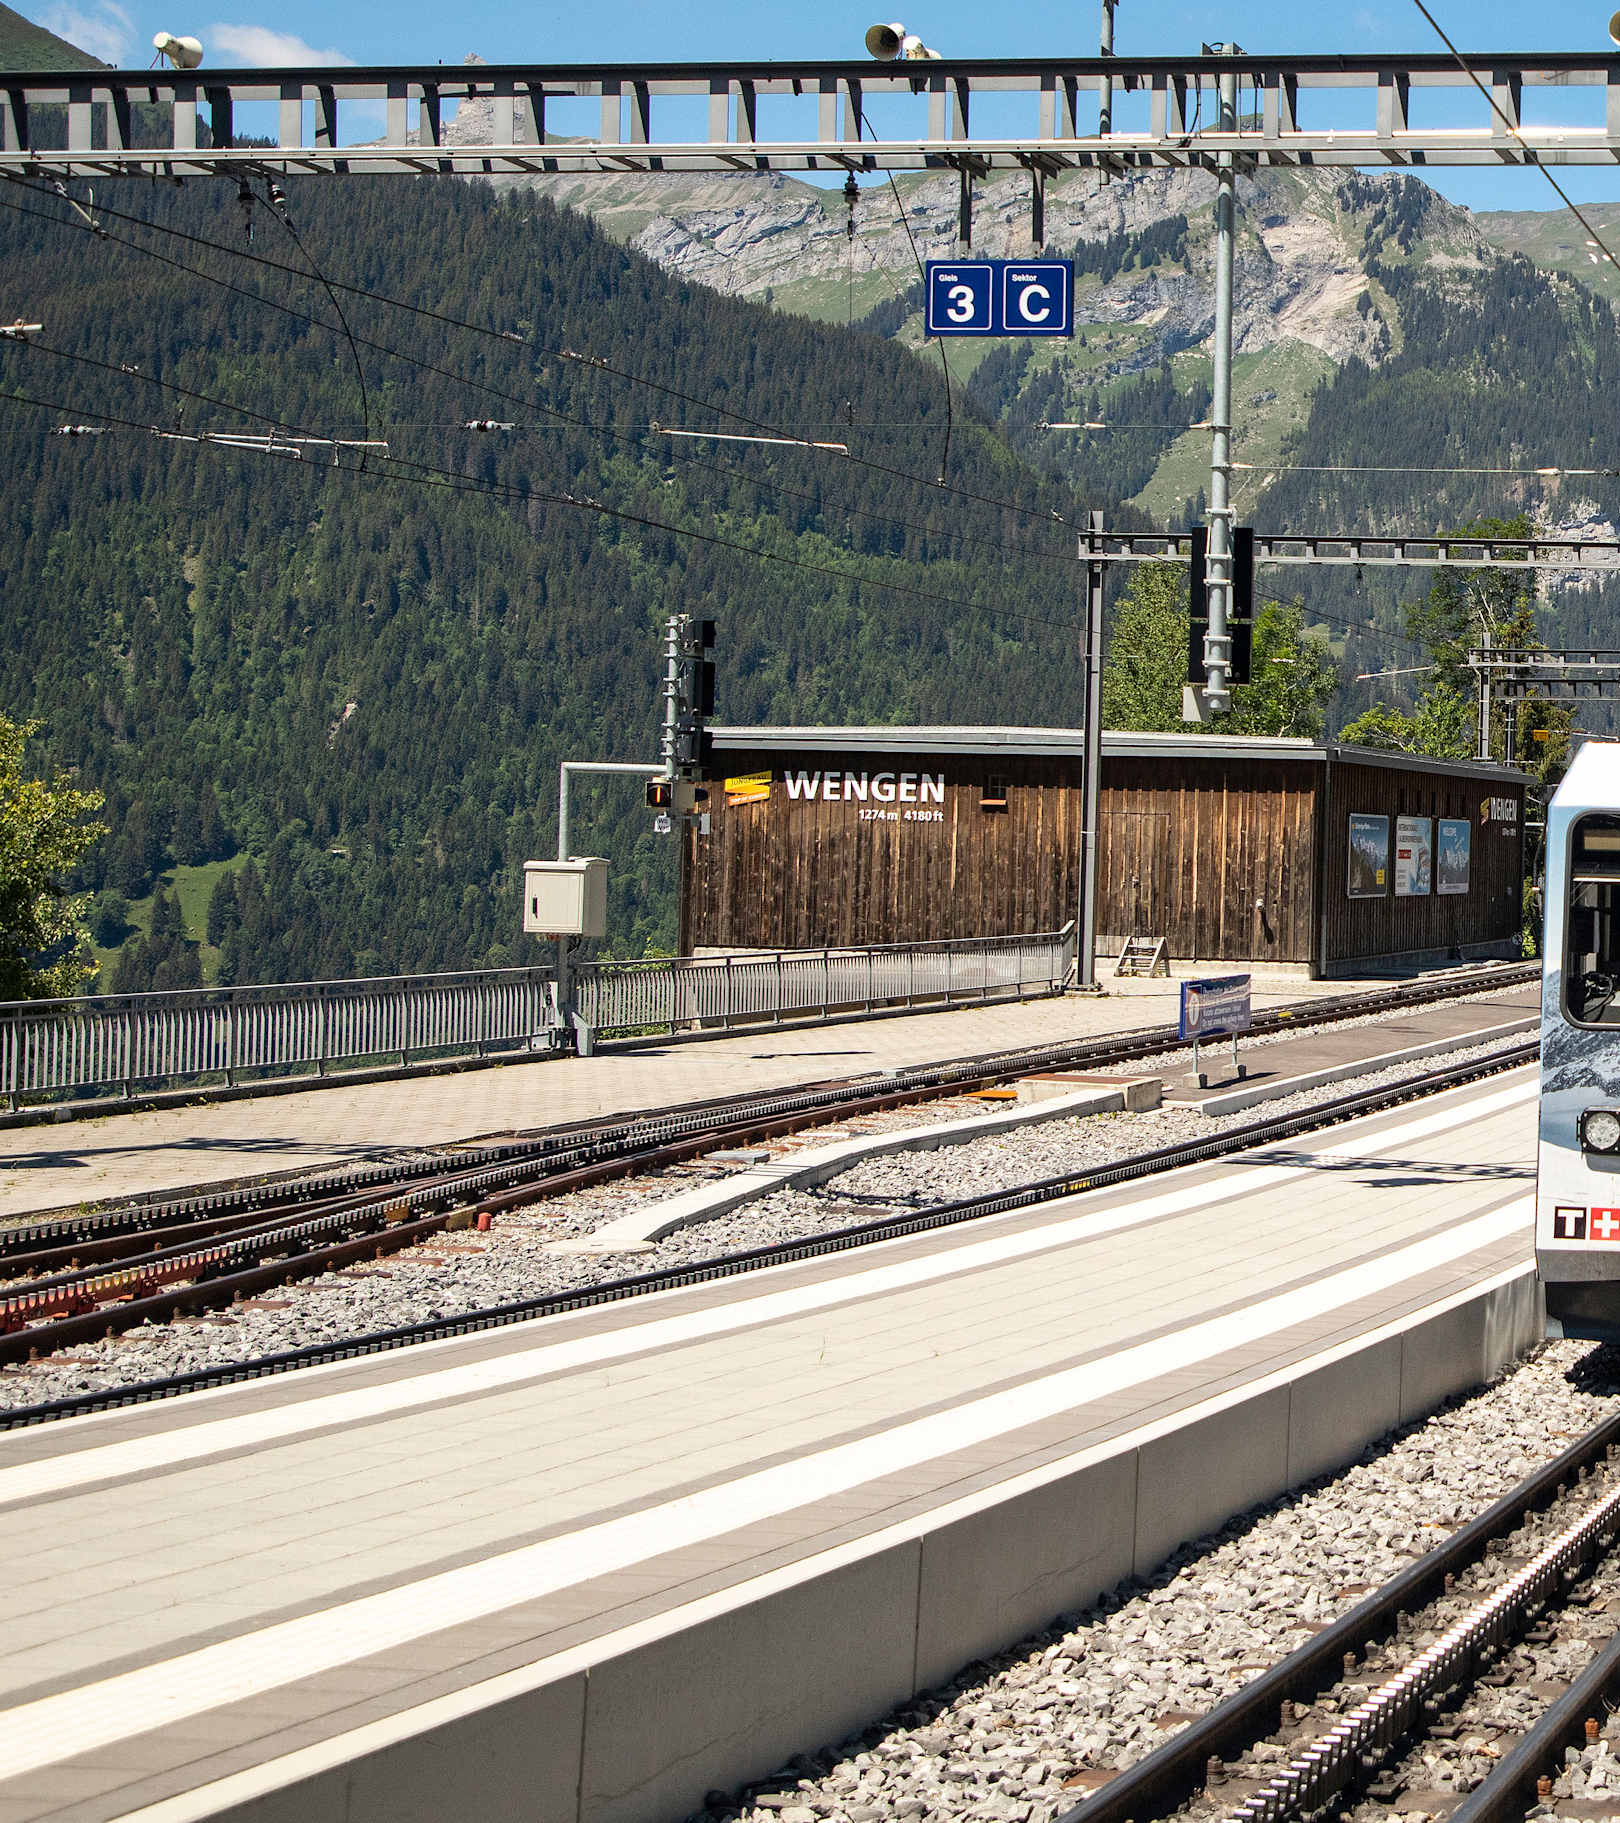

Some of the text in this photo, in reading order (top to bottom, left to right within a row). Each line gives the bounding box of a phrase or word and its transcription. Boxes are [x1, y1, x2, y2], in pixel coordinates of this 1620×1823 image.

[938, 274, 958, 282] Gleis
[1012, 274, 1037, 282] Sektor
[947, 285, 975, 323] 3
[1018, 284, 1051, 323] C
[784, 770, 945, 803] WENGEN
[858, 809, 886, 820] 1274
[904, 810, 931, 822] 4180
[1490, 797, 1517, 822] WENGEN
